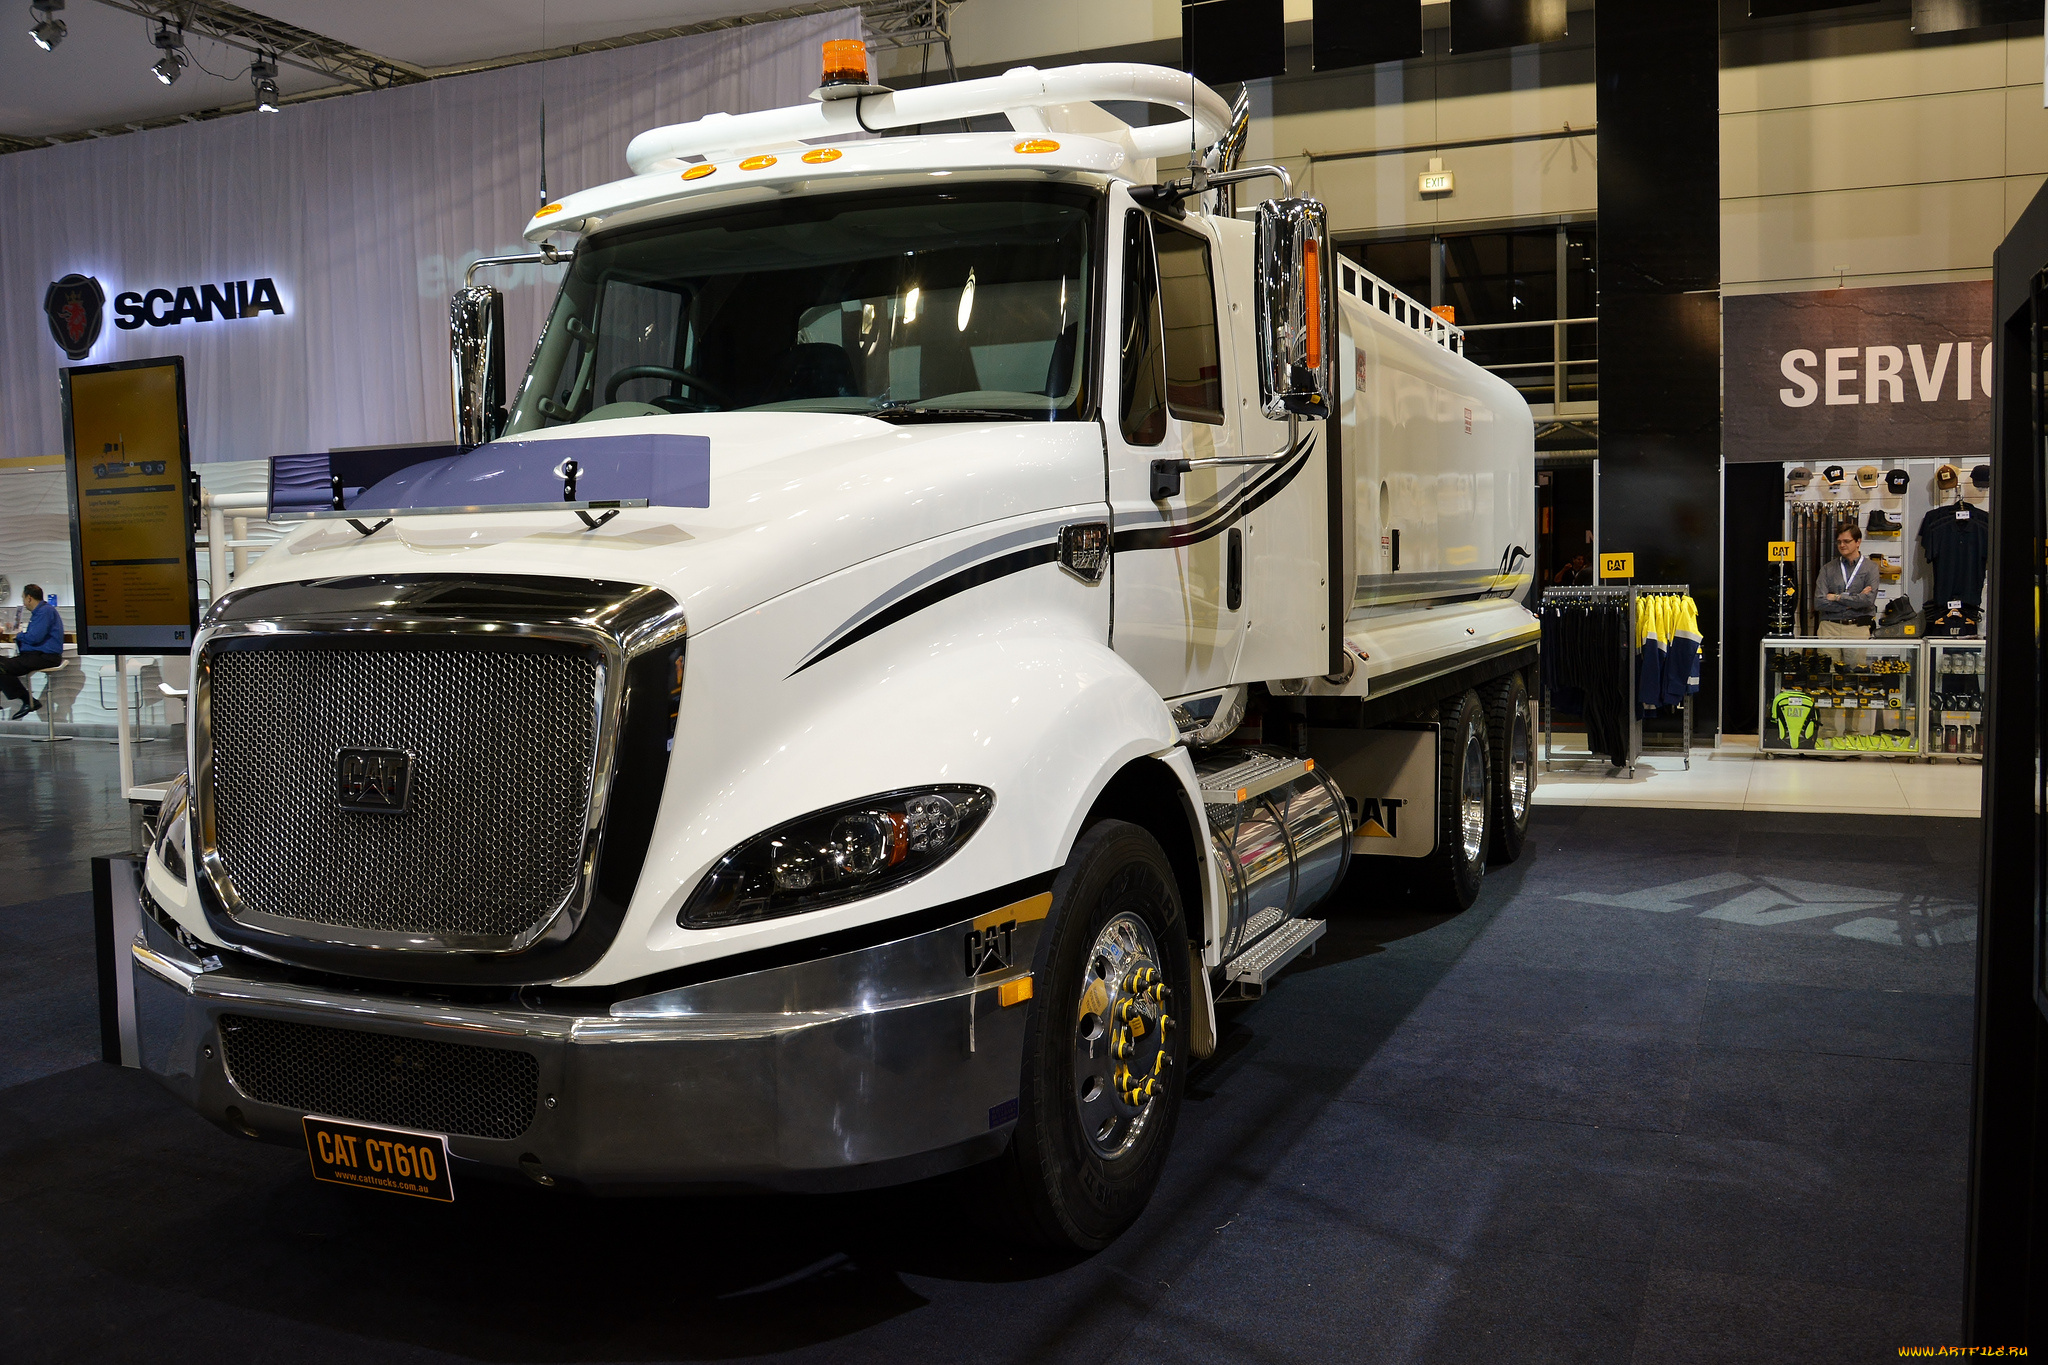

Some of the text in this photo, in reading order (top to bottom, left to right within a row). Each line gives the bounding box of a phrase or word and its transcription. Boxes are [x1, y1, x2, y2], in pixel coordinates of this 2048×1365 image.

[1425, 176, 1445, 188] EXIT
[113, 277, 285, 331] SCANIA
[1772, 546, 1790, 557] CAT
[1607, 559, 1626, 571] CAT
[1787, 707, 1804, 718] CAT
[342, 754, 403, 804] CAT
[963, 918, 1017, 978] CAT
[317, 1130, 437, 1181] CAT CT610
[334, 1170, 429, 1194] www.cattrucks.com.au
